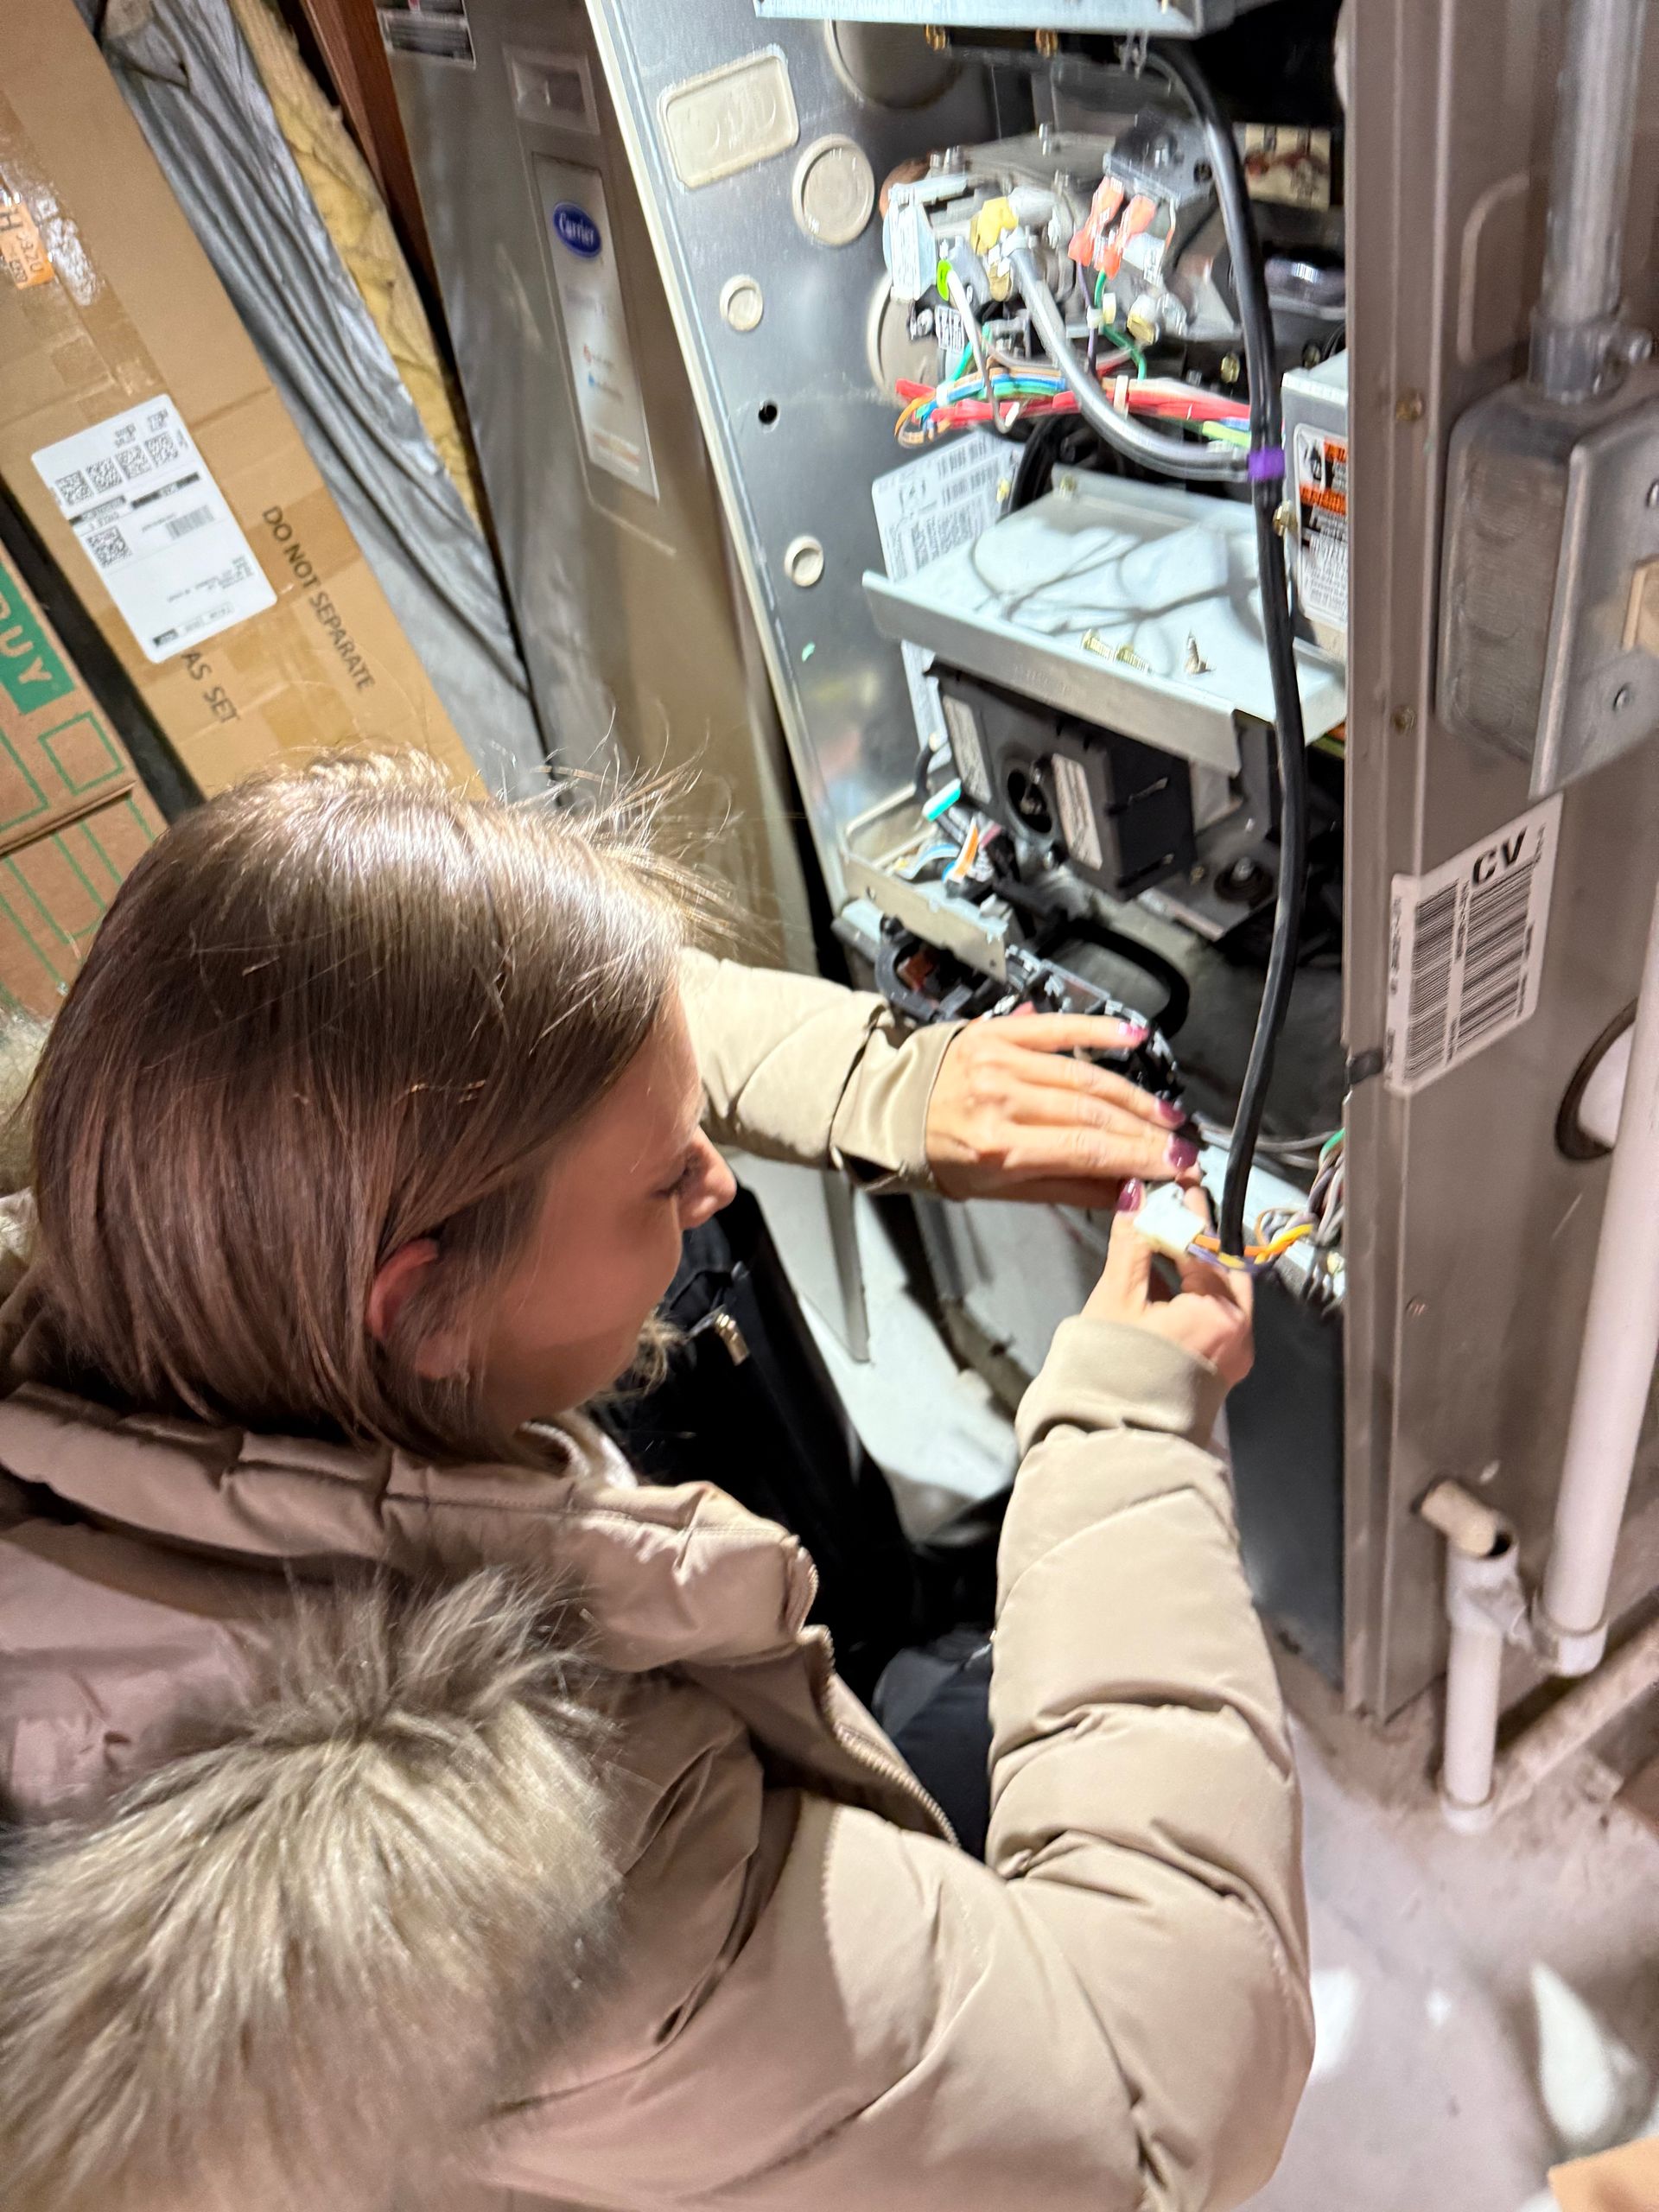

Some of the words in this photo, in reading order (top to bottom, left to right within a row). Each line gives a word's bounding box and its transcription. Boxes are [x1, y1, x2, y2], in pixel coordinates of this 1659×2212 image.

[558, 210, 596, 247] Carrier
[263, 505, 293, 542] DO
[283, 543, 321, 589] NOT
[308, 591, 376, 690] SEPARATE
[181, 651, 213, 681] AS
[203, 686, 240, 723] SET
[1472, 825, 1528, 887] CV
